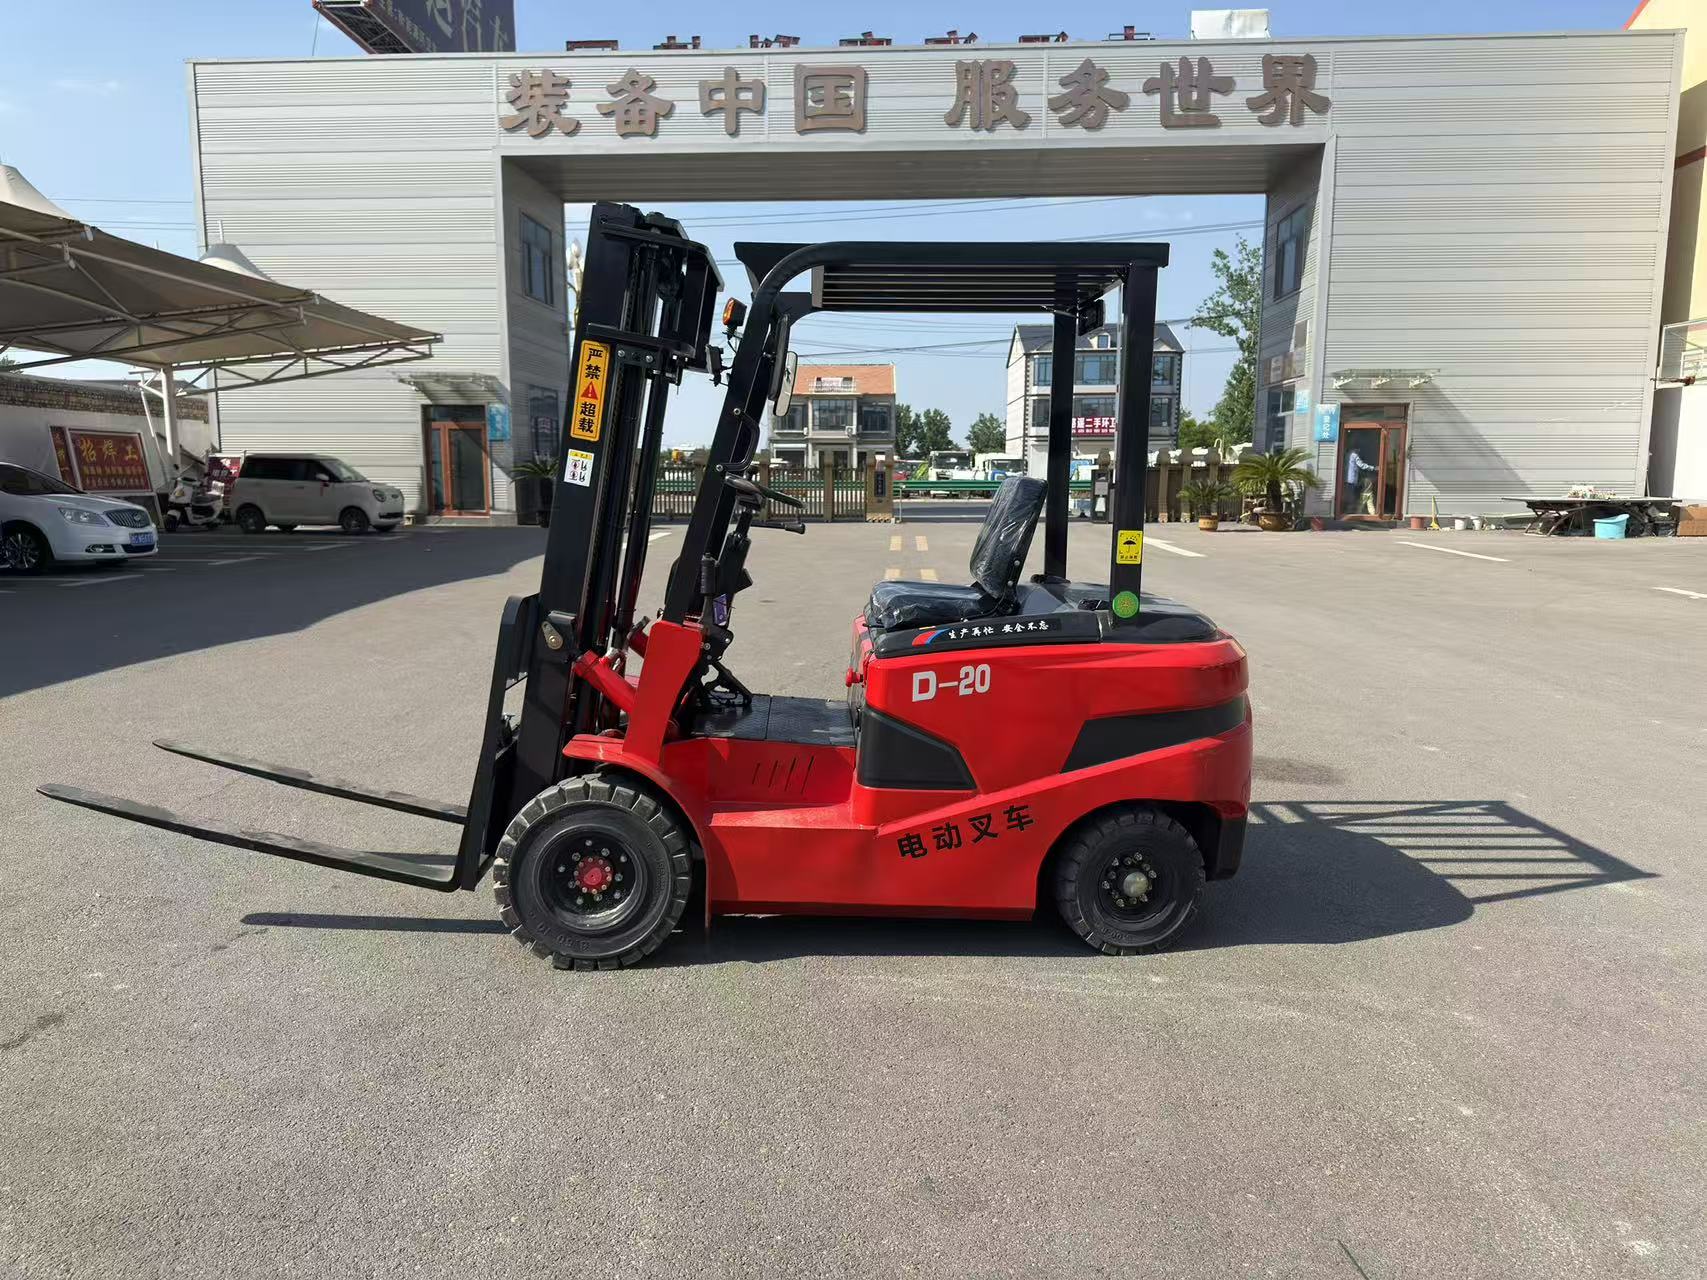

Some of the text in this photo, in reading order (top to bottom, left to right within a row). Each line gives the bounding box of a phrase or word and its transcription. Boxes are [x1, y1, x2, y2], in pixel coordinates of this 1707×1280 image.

[499, 54, 1330, 139] 装备中国 服务世界
[585, 347, 603, 380] 严禁
[578, 401, 597, 434] 超载
[948, 620, 1050, 640] 生产再忙 安全不忘
[911, 663, 991, 703] D-20
[896, 804, 1035, 860] 电动叉车
